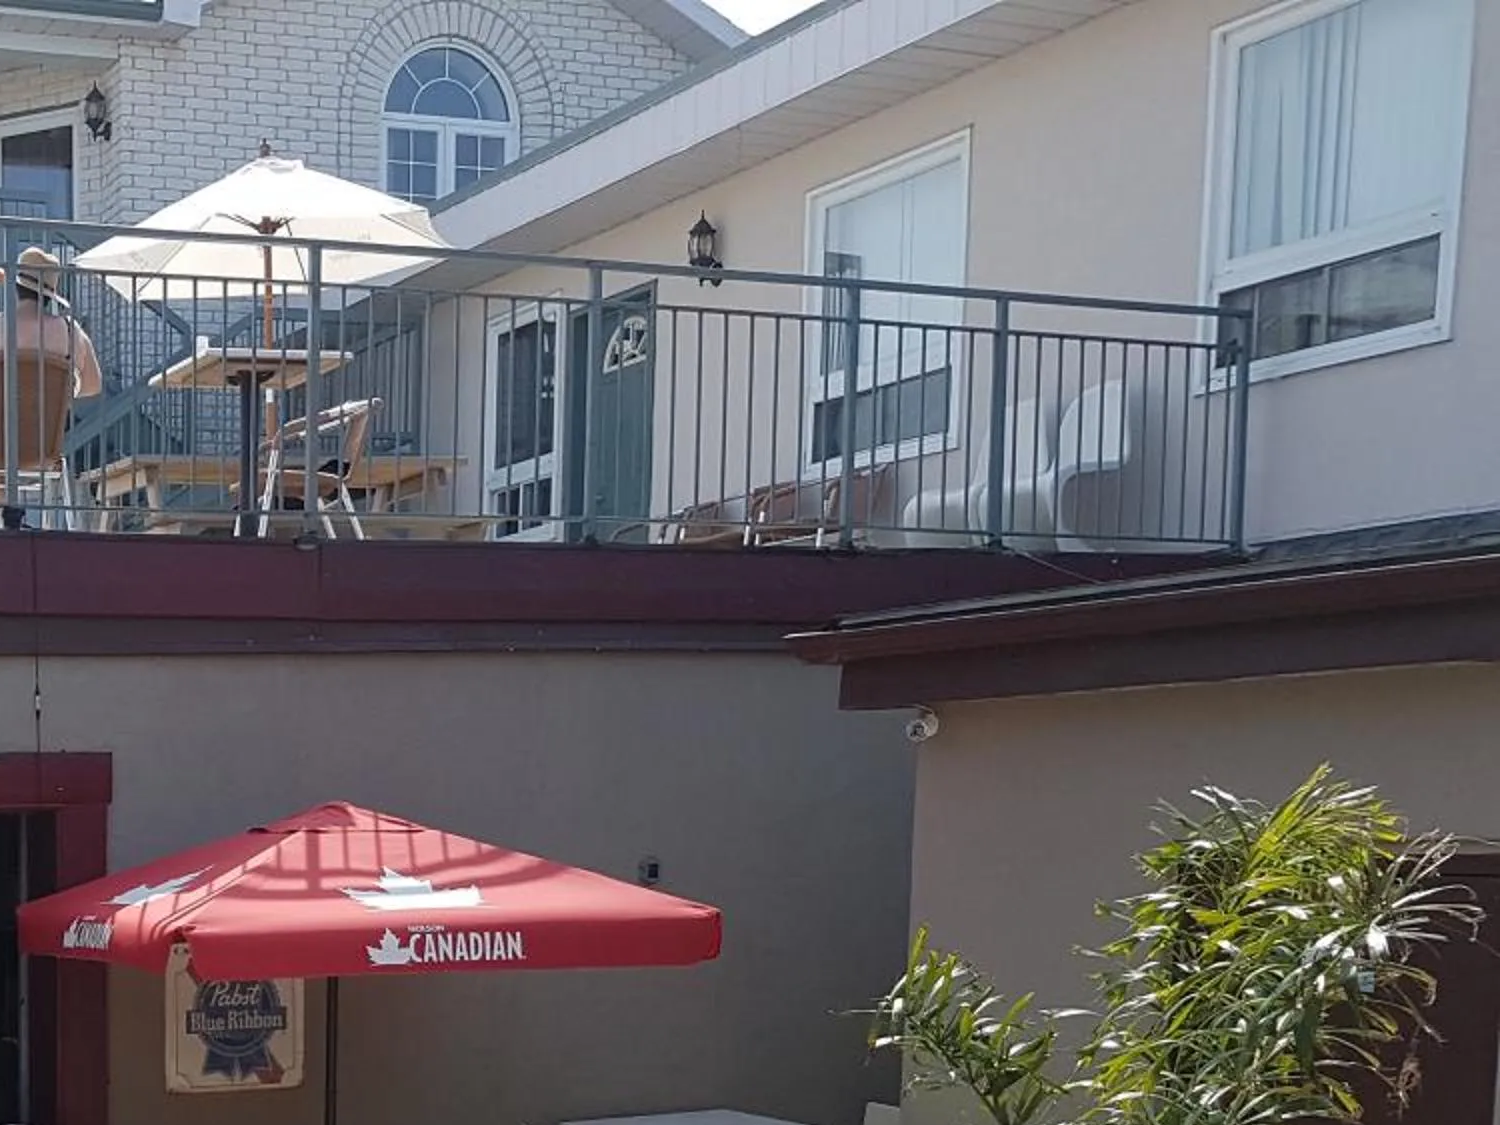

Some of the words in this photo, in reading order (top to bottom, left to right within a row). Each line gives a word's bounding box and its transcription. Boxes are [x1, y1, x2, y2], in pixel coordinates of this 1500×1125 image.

[409, 931, 523, 963] CANADIAN
[210, 980, 262, 1007] Pabst
[190, 1011, 226, 1031] Blue
[227, 1007, 284, 1030] Ribbon
